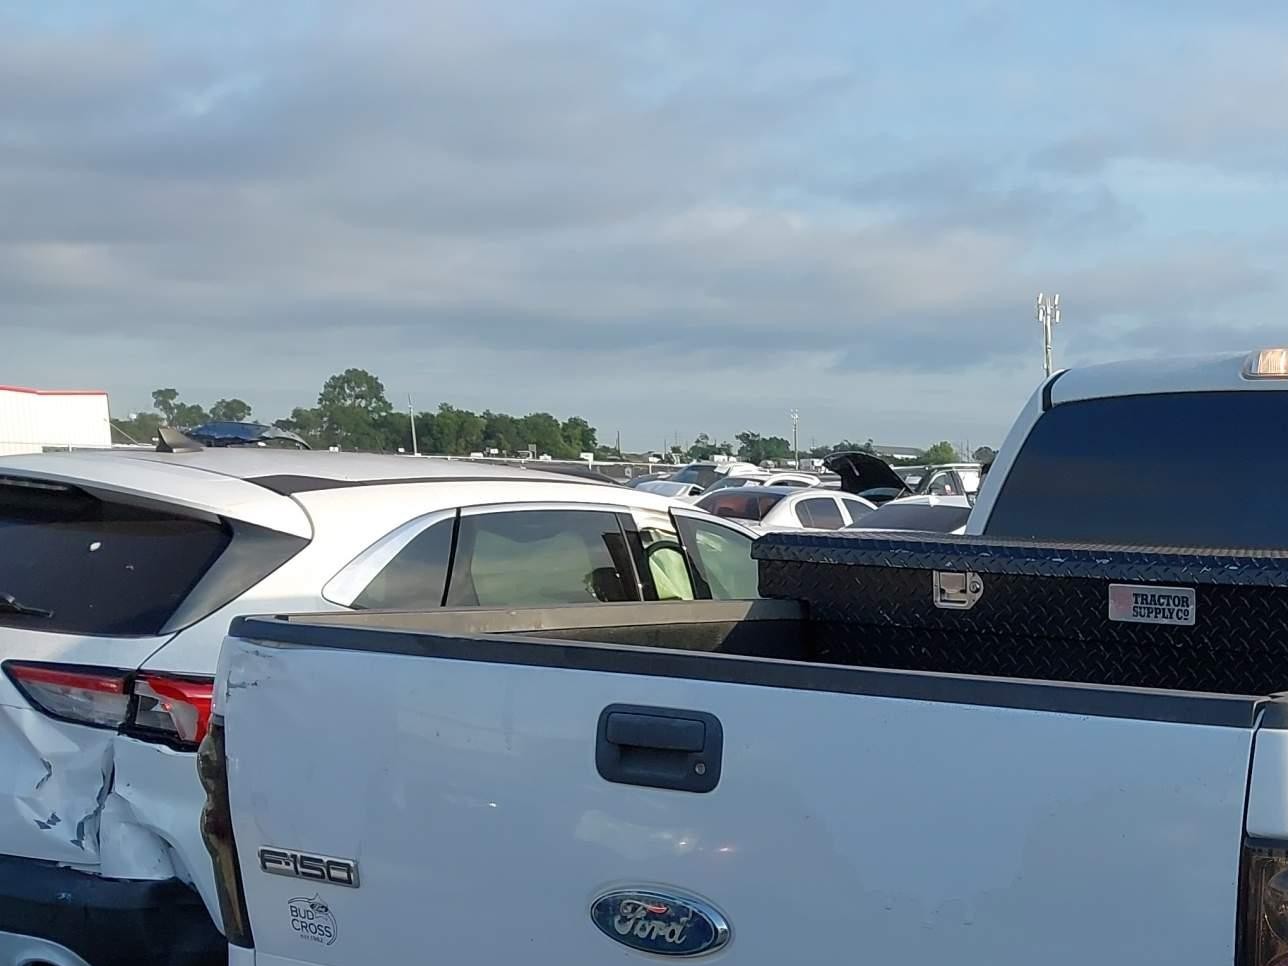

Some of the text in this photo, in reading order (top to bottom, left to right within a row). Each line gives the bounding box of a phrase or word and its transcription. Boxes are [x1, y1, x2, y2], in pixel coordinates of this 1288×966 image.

[1133, 593, 1189, 608] TRACTOR
[260, 849, 353, 884] F-150
[289, 905, 316, 921] BUD
[614, 900, 692, 943] Ford
[291, 918, 333, 938] CROSS
